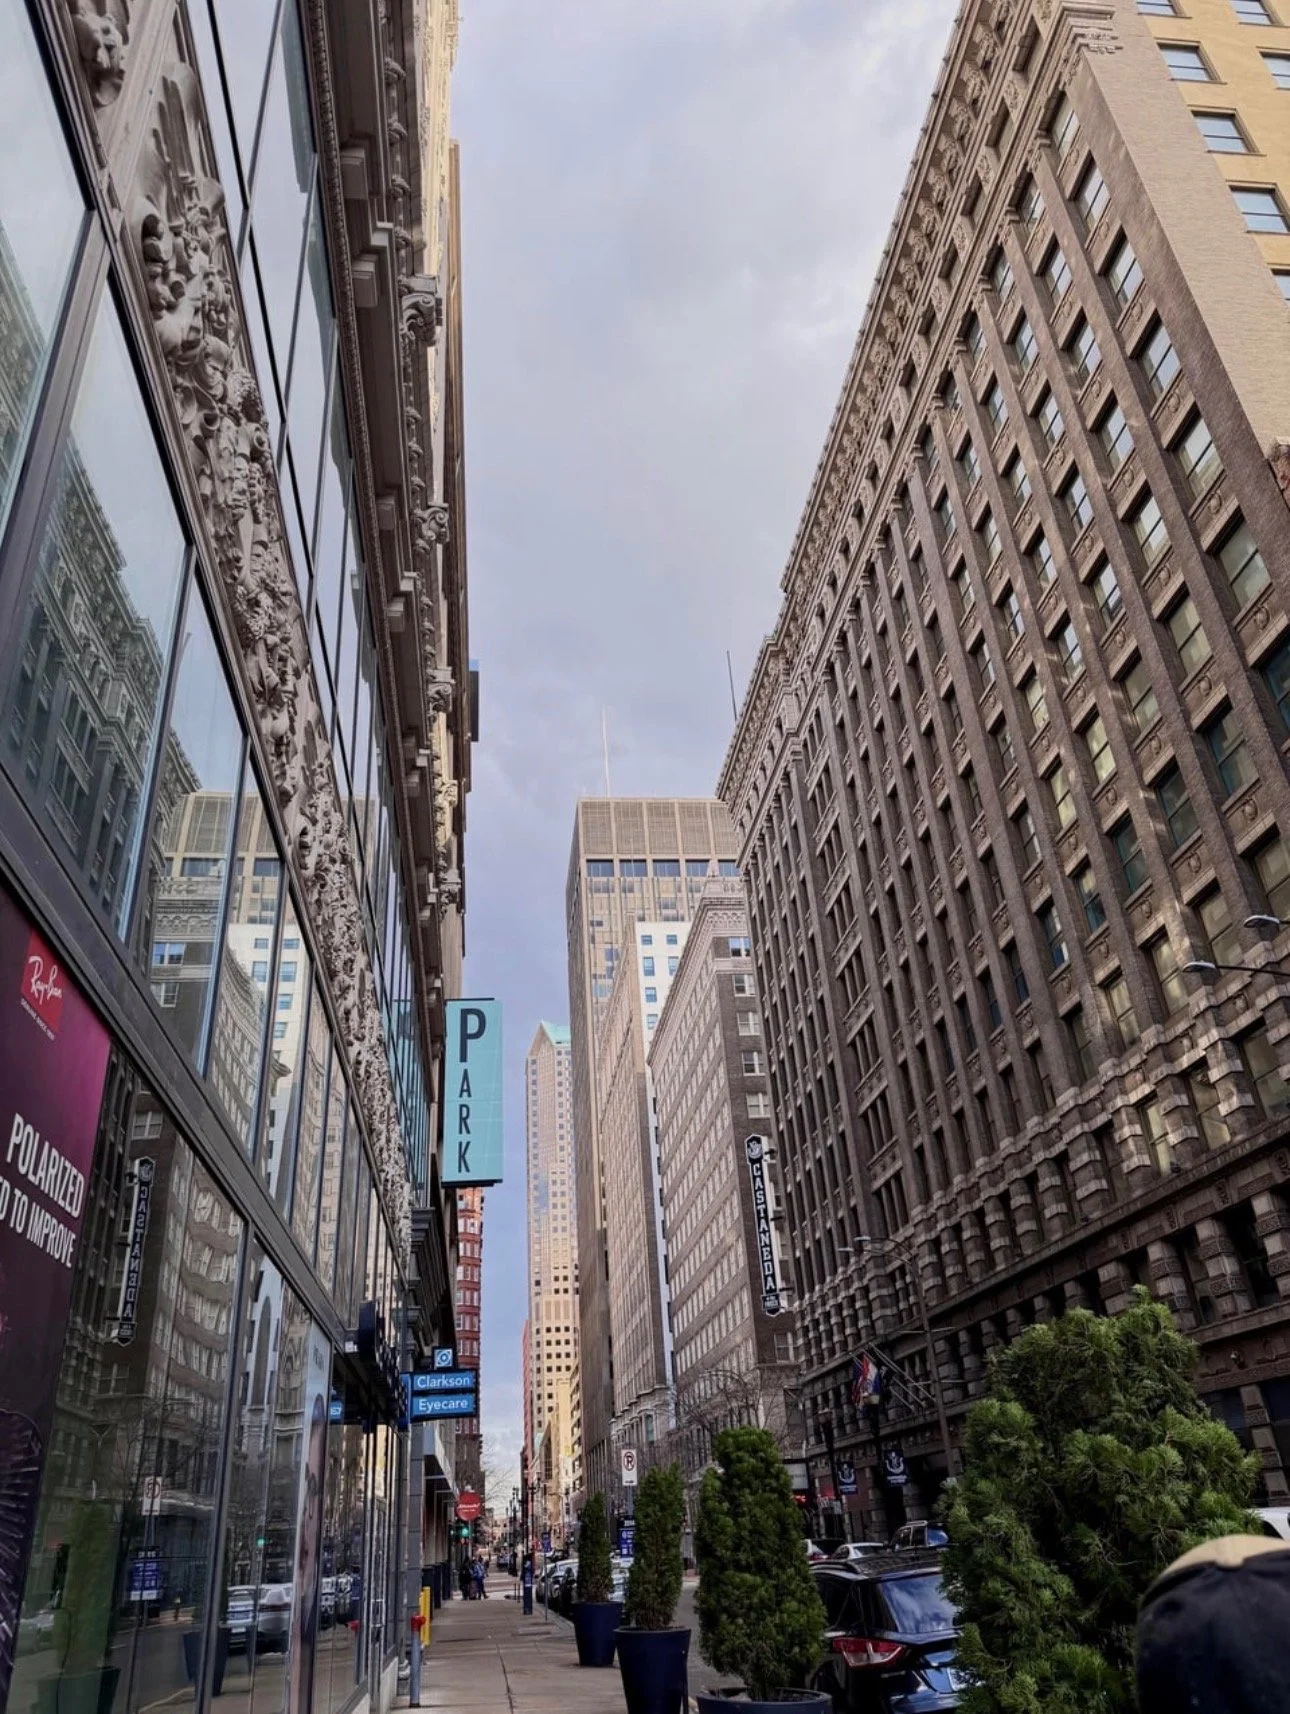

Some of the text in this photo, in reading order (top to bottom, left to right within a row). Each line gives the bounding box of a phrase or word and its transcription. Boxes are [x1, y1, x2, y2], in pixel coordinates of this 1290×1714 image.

[458, 1008, 487, 1173] PARK
[6, 1112, 85, 1218] POLARIZED
[10, 1187, 29, 1234] TO
[26, 1202, 76, 1268] IMPROVE
[753, 1163, 776, 1290] CASTANEDA
[417, 1374, 470, 1388] Clarkson
[418, 1399, 469, 1413] Eyecare
